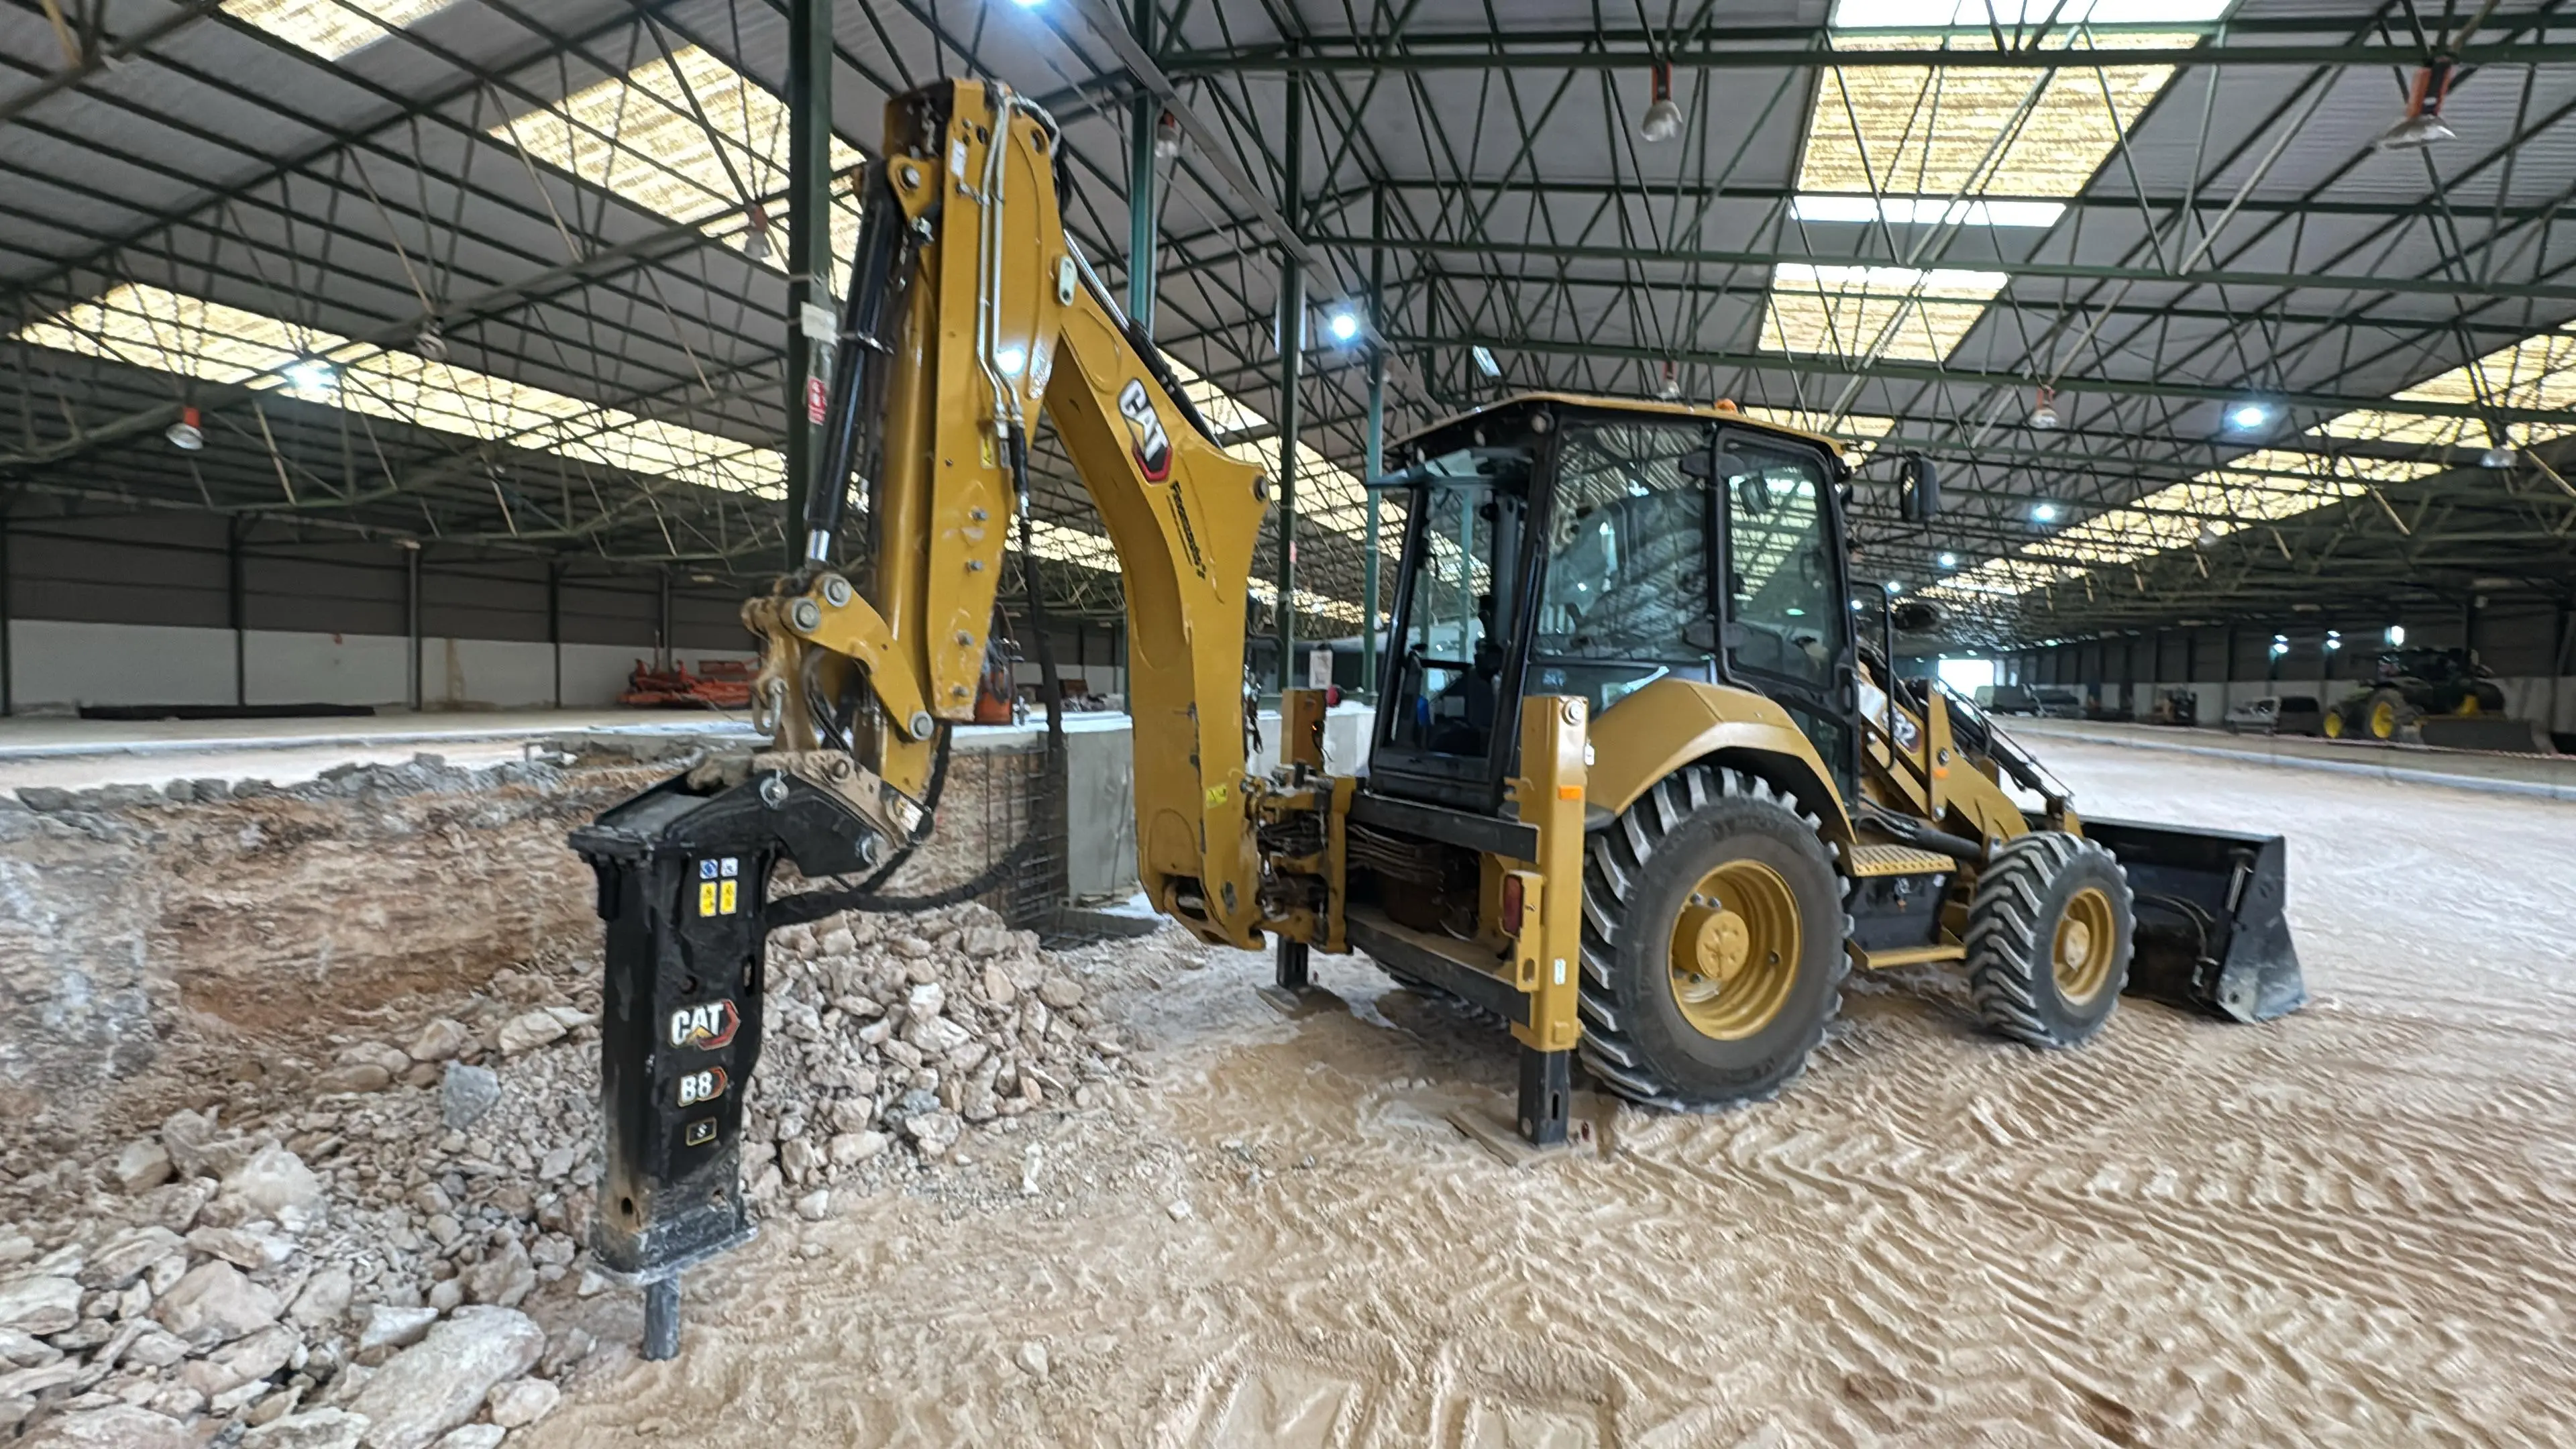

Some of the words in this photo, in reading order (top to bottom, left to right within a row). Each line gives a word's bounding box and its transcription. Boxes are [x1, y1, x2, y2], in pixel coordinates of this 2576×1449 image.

[1120, 379, 1169, 462] CAT
[672, 1003, 724, 1044] CAT
[681, 1071, 712, 1102] B8
